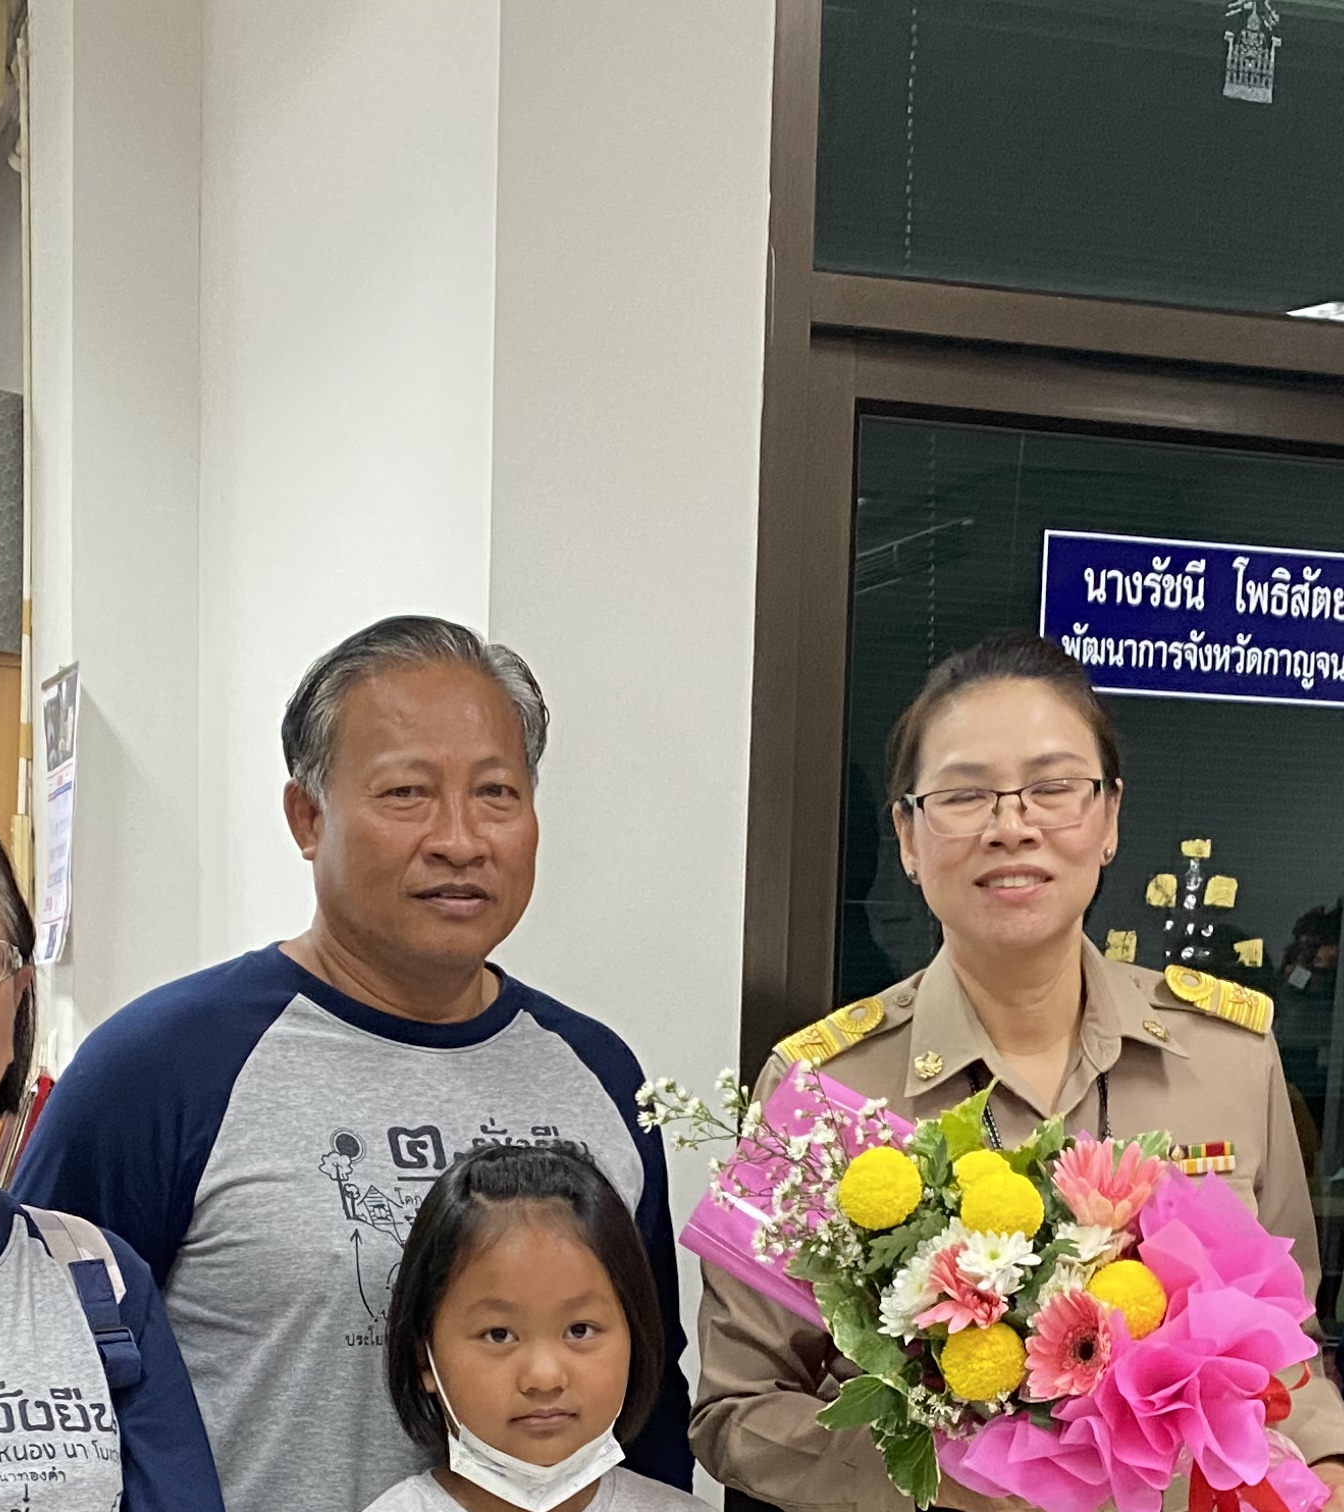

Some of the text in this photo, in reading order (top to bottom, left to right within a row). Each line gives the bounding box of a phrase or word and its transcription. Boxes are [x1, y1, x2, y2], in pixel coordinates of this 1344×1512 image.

[1085, 555, 1206, 611] นางรัชนี
[63, 1442, 89, 1460] นา
